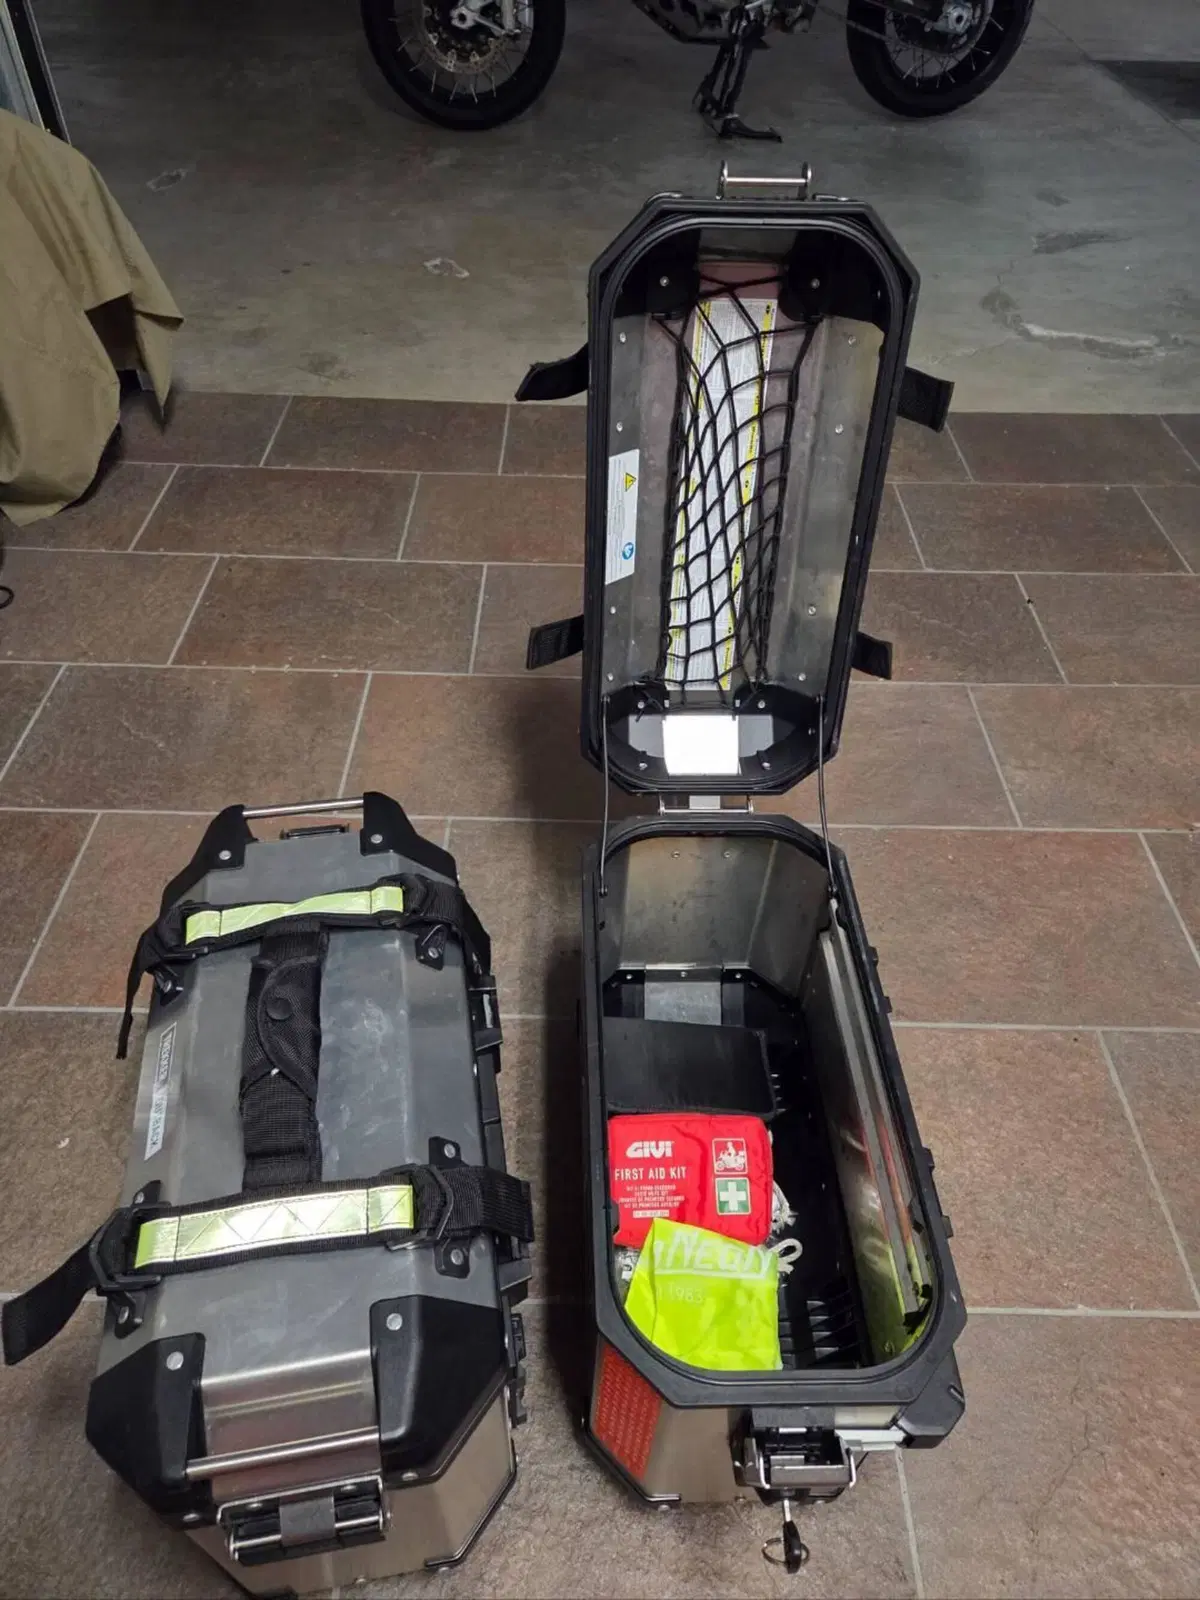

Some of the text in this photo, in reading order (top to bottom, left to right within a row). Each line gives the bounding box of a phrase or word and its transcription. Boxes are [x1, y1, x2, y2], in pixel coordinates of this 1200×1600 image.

[626, 1140, 672, 1158] GIVI
[614, 1165, 687, 1181] FIRST AID KIT
